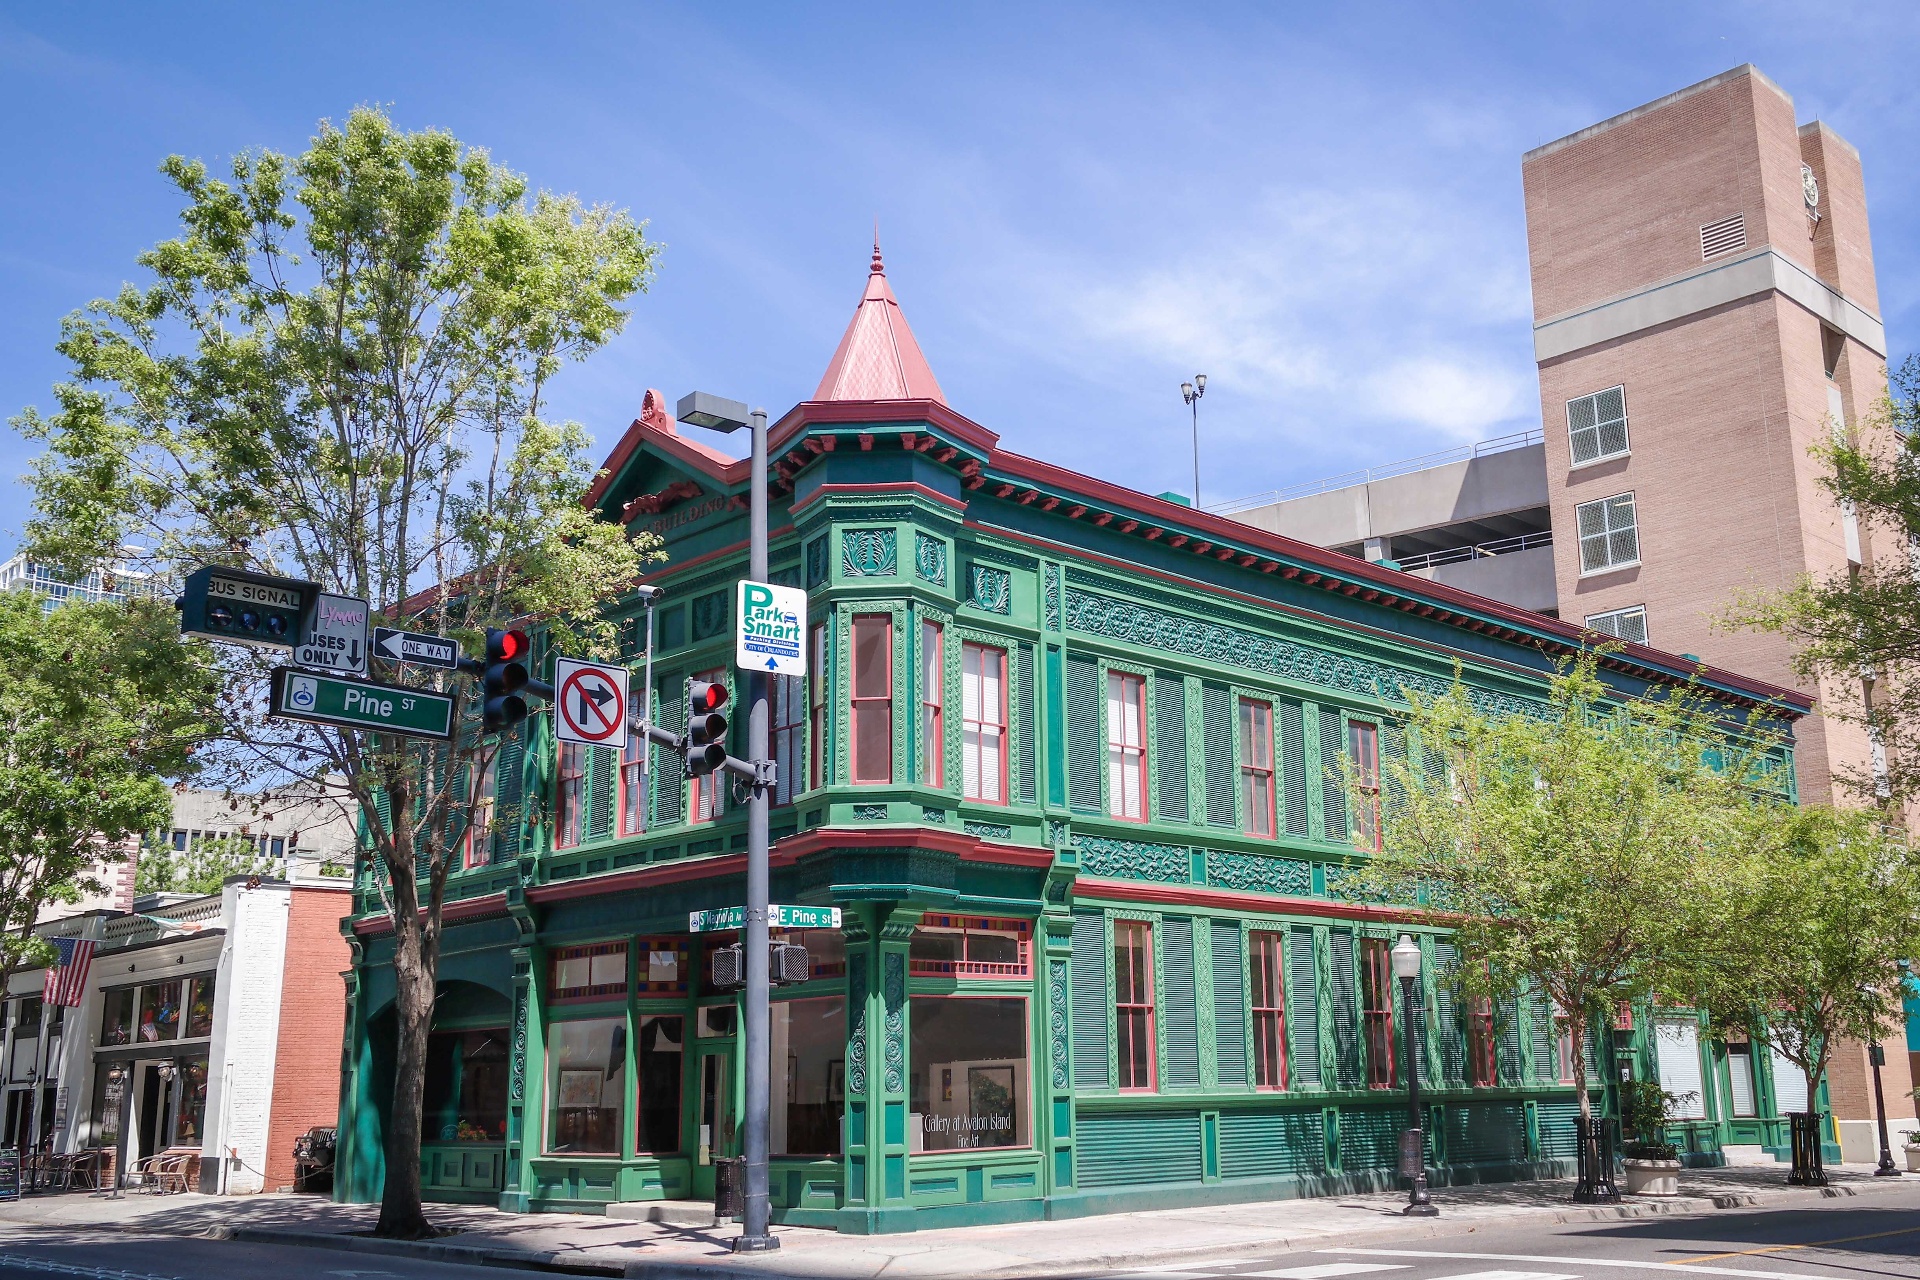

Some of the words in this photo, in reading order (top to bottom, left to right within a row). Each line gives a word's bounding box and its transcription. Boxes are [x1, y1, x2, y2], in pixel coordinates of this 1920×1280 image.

[653, 495, 725, 535] BUILDING
[208, 580, 236, 596] BUS
[241, 586, 299, 607] SIGNAL
[744, 584, 785, 623] Park
[742, 616, 800, 641] Smart
[308, 633, 346, 651] USES
[401, 640, 422, 655] ONE
[426, 644, 450, 659] WAY
[749, 636, 771, 644] Parking
[772, 639, 795, 647] Division
[302, 648, 340, 666] ONLY
[343, 688, 393, 717] Pine
[401, 697, 417, 711] ST
[699, 912, 705, 926] S
[779, 908, 787, 923] E
[792, 909, 817, 924] Pine
[821, 913, 832, 924] St
[924, 1114, 950, 1136] Gallery
[952, 1115, 960, 1131] at
[962, 1113, 988, 1132] Avalon
[990, 1112, 1011, 1131] Island
[957, 1134, 969, 1148] Fine
[970, 1133, 980, 1147] Art
